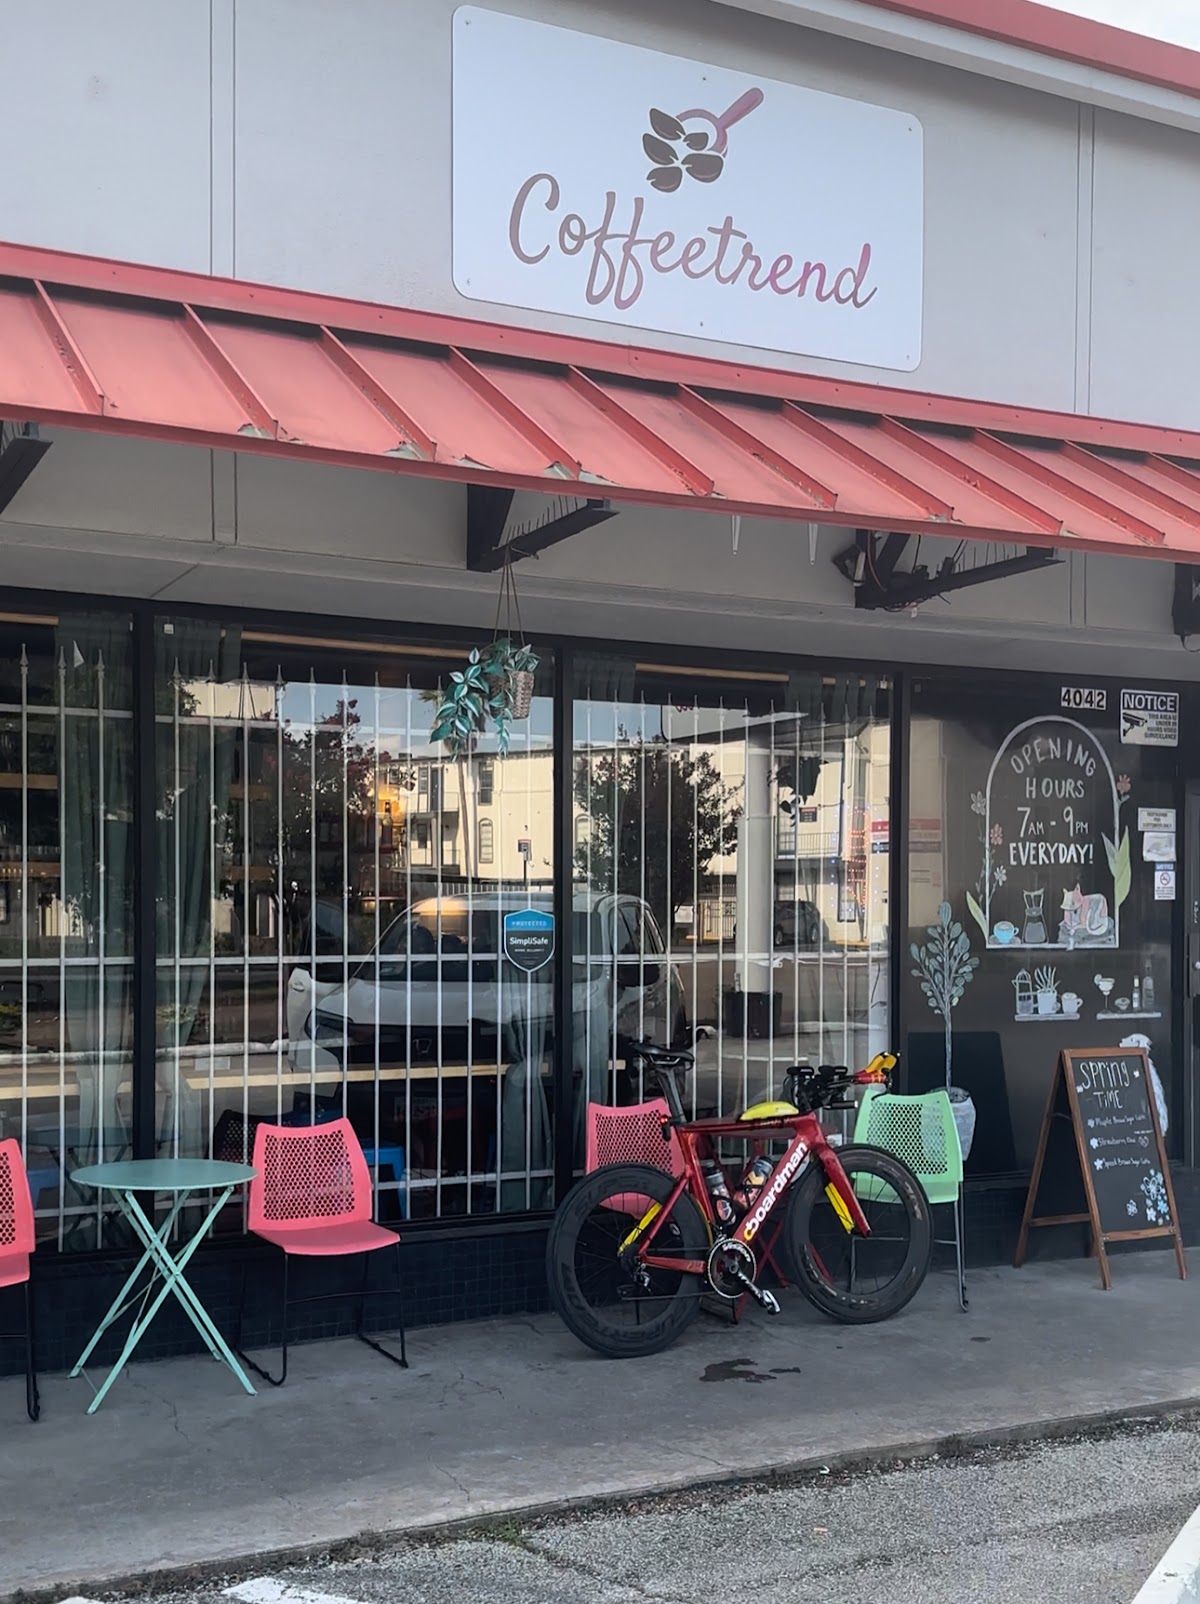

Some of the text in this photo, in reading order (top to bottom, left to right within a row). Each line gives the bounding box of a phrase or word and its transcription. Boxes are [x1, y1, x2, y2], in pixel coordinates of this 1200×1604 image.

[509, 172, 878, 310] Coffeetrend
[1062, 688, 1105, 709] 4042
[1123, 693, 1176, 712] NOTICE
[1010, 736, 1096, 777] OPENING
[1025, 777, 1085, 799] HOURS
[1009, 841, 1094, 866] EVERYDAY!
[509, 936, 549, 946] SimpliSafe
[743, 1141, 808, 1241] boardman
